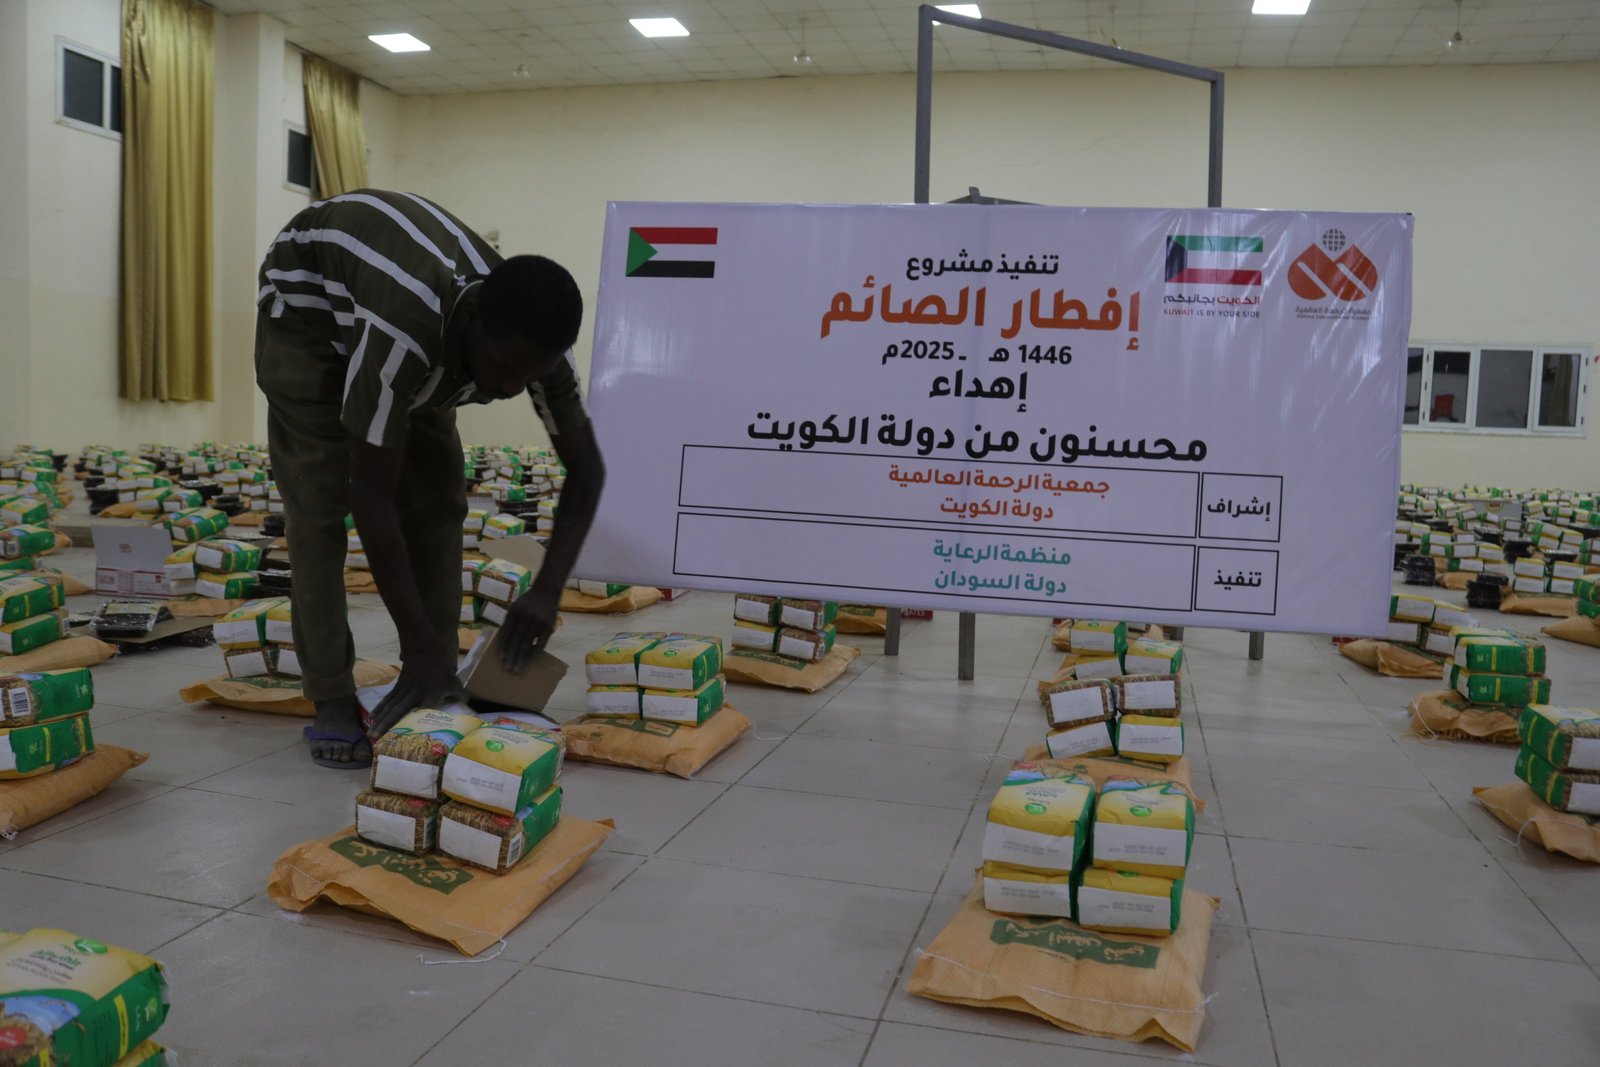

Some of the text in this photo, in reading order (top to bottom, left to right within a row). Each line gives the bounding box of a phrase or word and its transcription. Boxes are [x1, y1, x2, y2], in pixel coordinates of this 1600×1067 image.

[905, 249, 1059, 280] تنفيذ مشروع
[820, 275, 1140, 351] إفطار الصائم
[1163, 308, 1260, 318] KUWAIT IS BY YOUR SIDE
[1217, 295, 1260, 307] الكويت
[1017, 344, 1073, 366] 1446
[928, 369, 1029, 412] إهداء
[747, 412, 1208, 463] محسنون من دولة الكويت
[889, 464, 1110, 499] جمعية الرحمة العالمية
[940, 497, 1054, 522] دولة الكويت
[1206, 497, 1271, 522] إشراف
[933, 539, 1071, 566] منظمة الرعاية
[935, 570, 1067, 597] دولة السودان
[1213, 571, 1263, 591] تنفيذ
